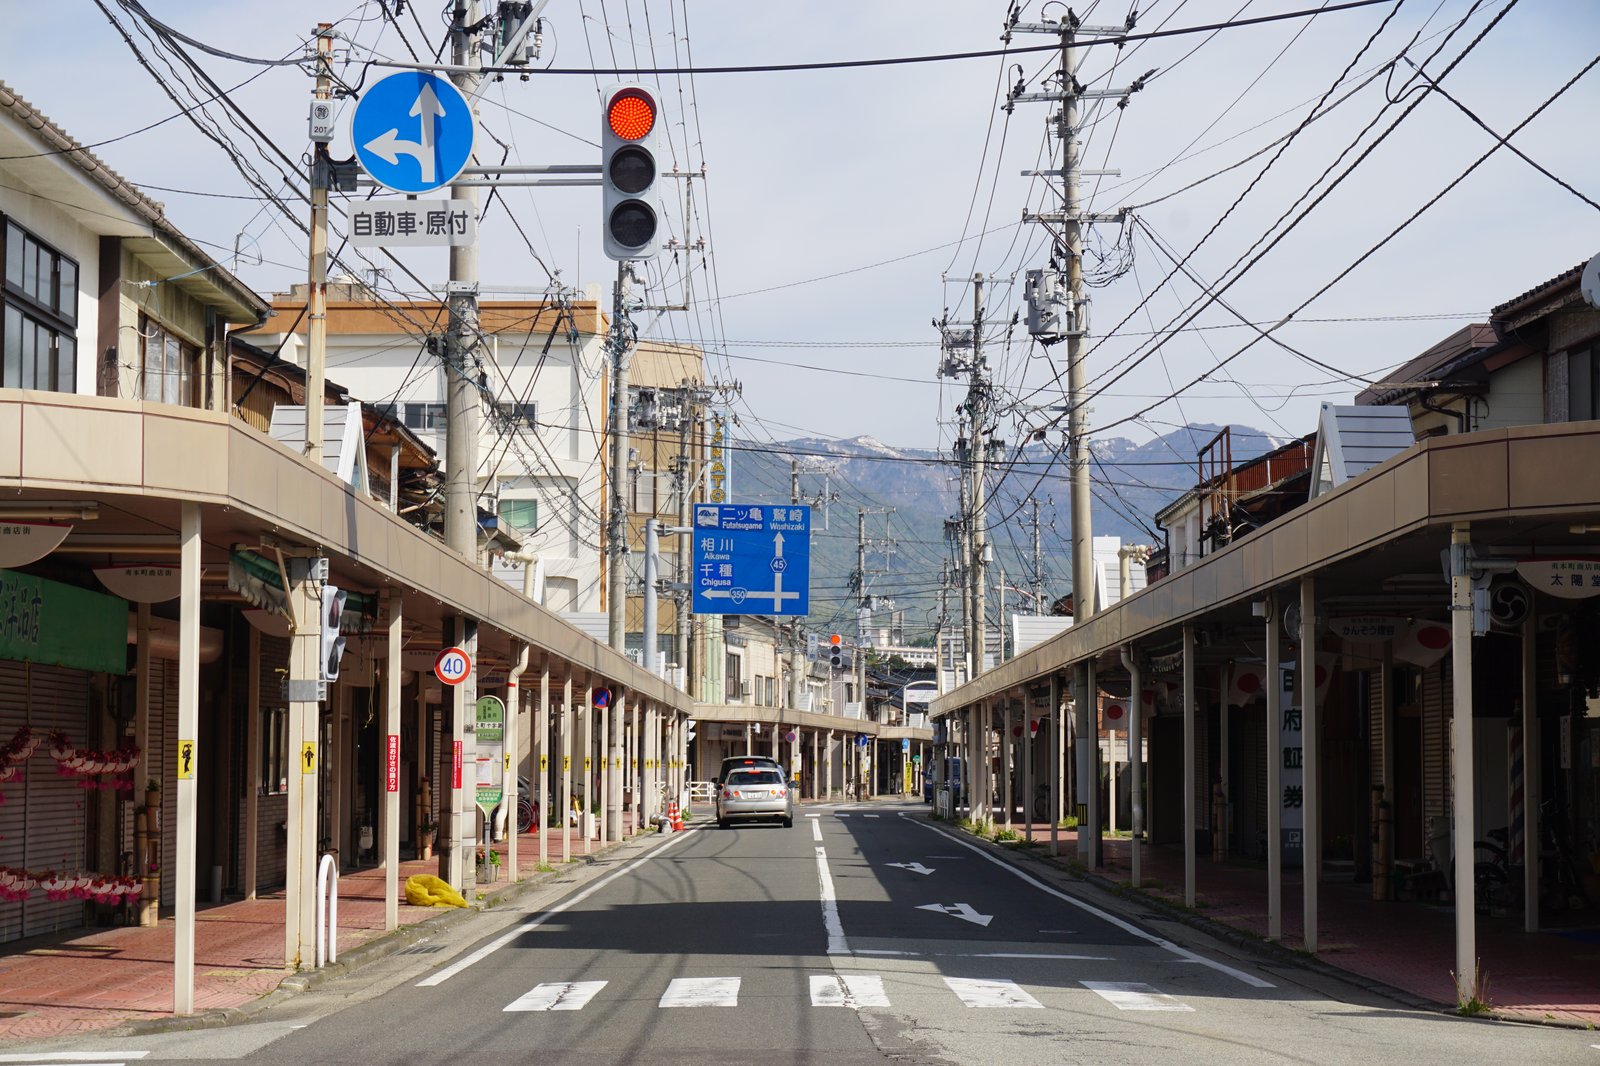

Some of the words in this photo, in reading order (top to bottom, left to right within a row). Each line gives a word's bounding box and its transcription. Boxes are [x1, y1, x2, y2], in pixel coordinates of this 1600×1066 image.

[722, 521, 763, 530] Futatsugame
[770, 523, 805, 531] Washizaki
[701, 538, 734, 552] 相川
[704, 552, 731, 560] Aikawa
[773, 561, 784, 569] 45
[700, 563, 733, 577] 千種
[701, 578, 732, 587] Chigusa
[732, 591, 745, 599] 350
[443, 657, 463, 675] 40
